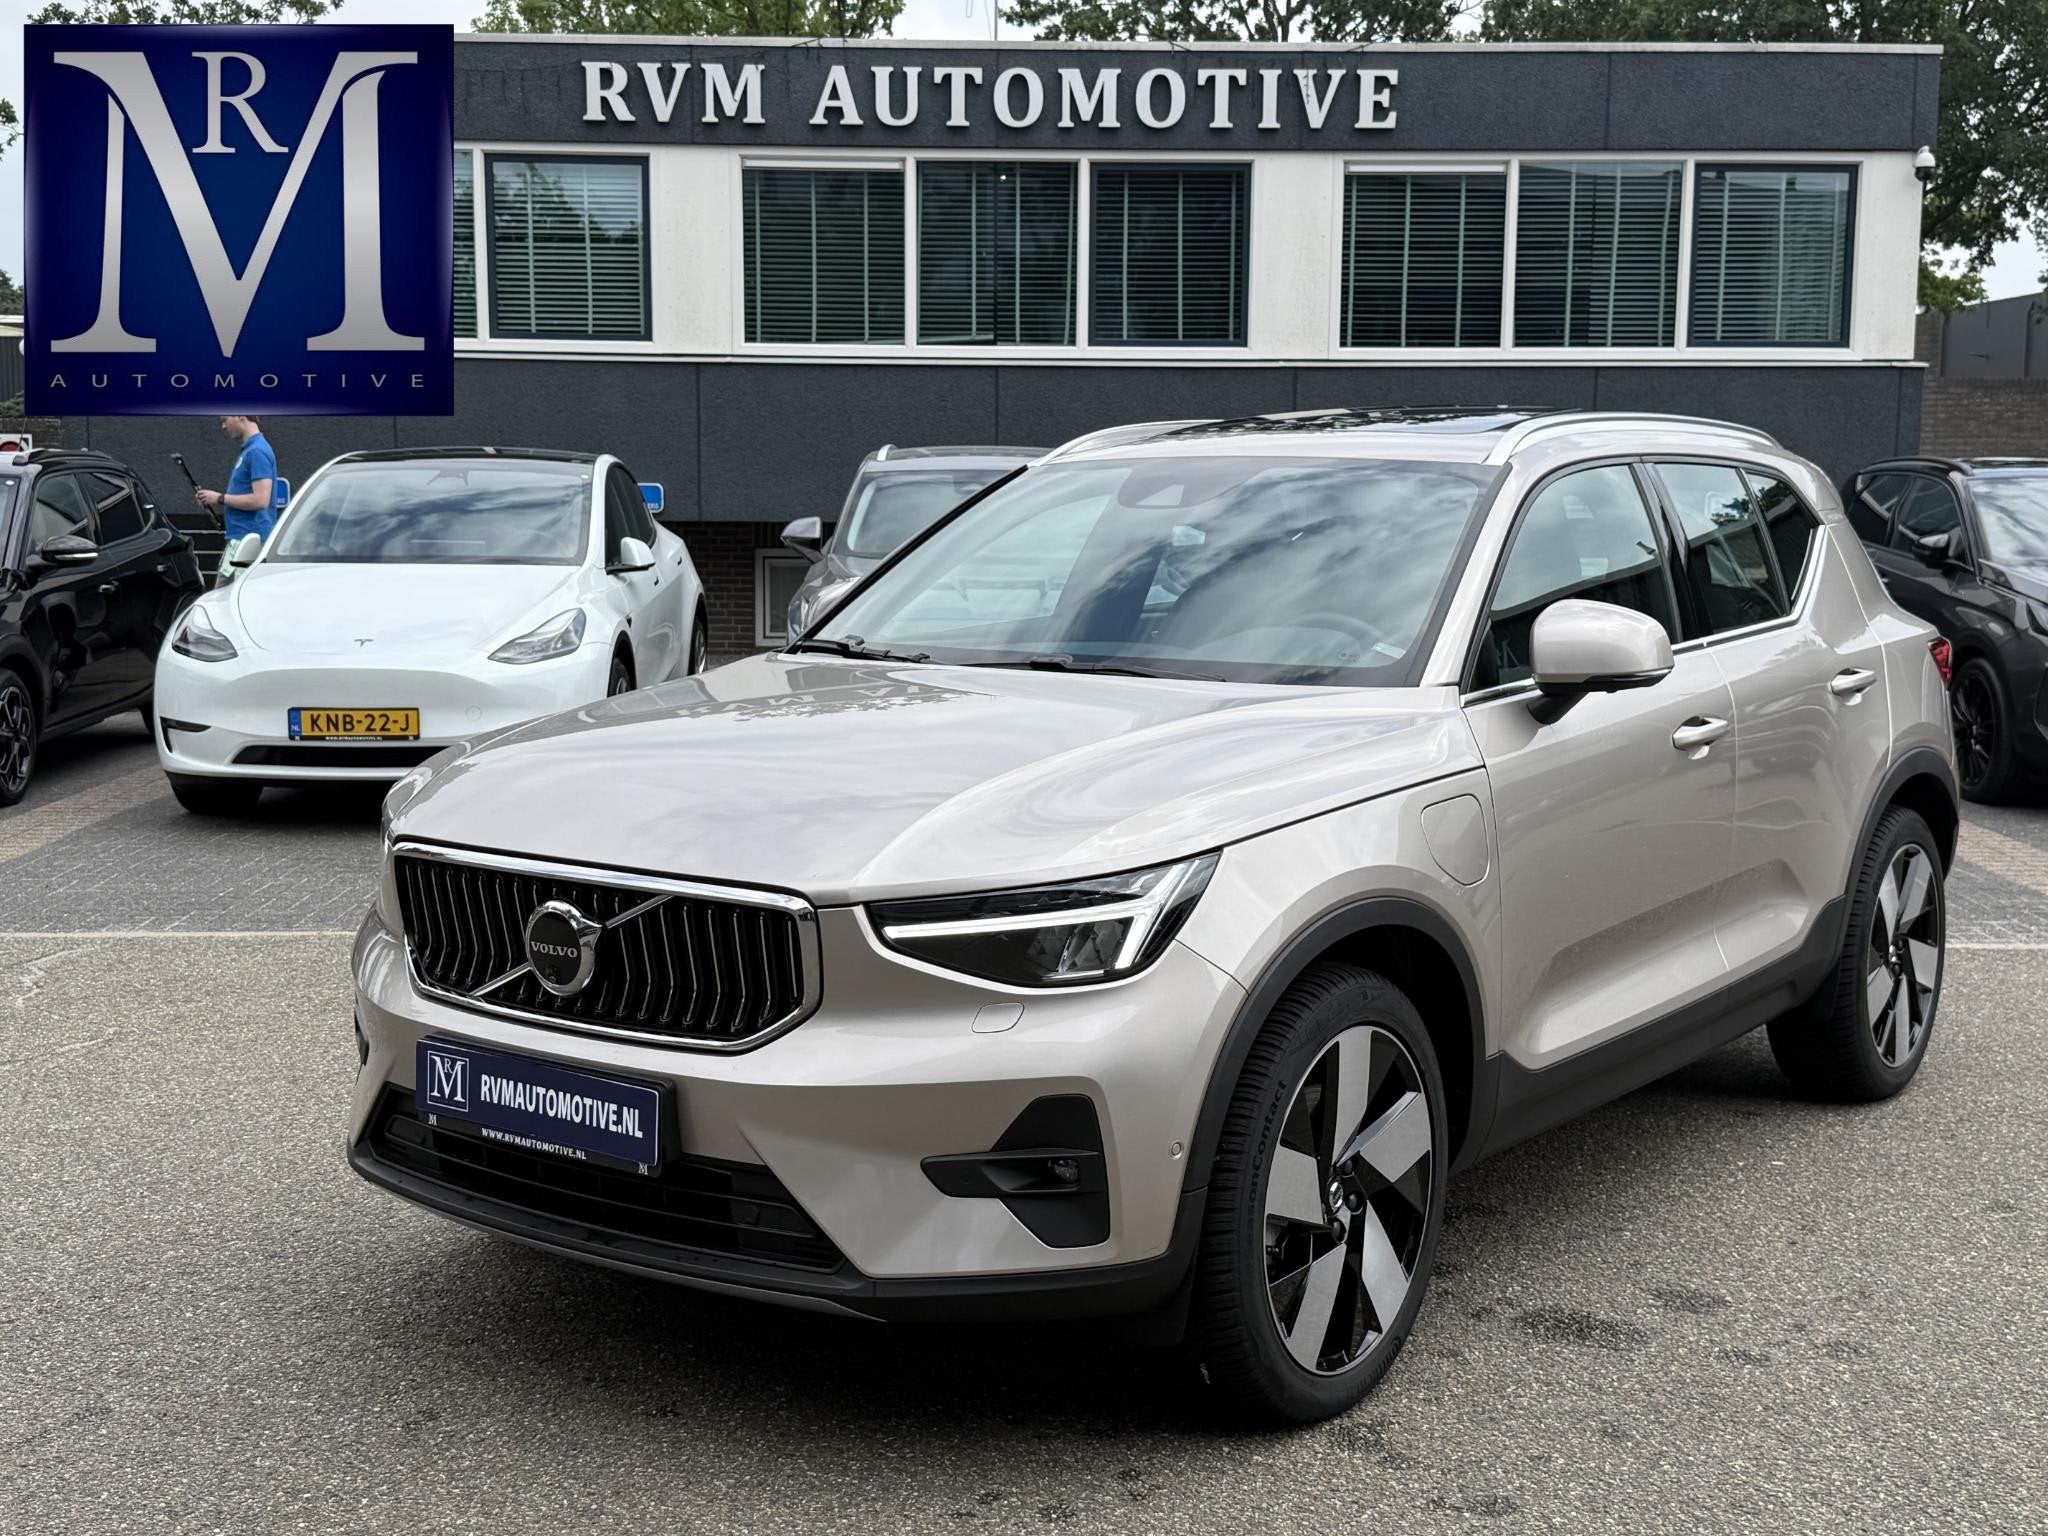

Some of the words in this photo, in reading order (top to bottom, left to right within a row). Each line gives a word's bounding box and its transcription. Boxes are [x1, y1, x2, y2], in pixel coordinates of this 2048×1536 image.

[582, 61, 765, 125] RVM
[809, 65, 1400, 131] AUTOMOTIVE
[310, 713, 410, 732] KNB-22-J
[531, 941, 578, 958] VOLVO
[480, 1073, 643, 1139] RVMAUTOMOTIVE.NL
[481, 1127, 587, 1160] WWW.RVMAUTOMOTIVE.NL
